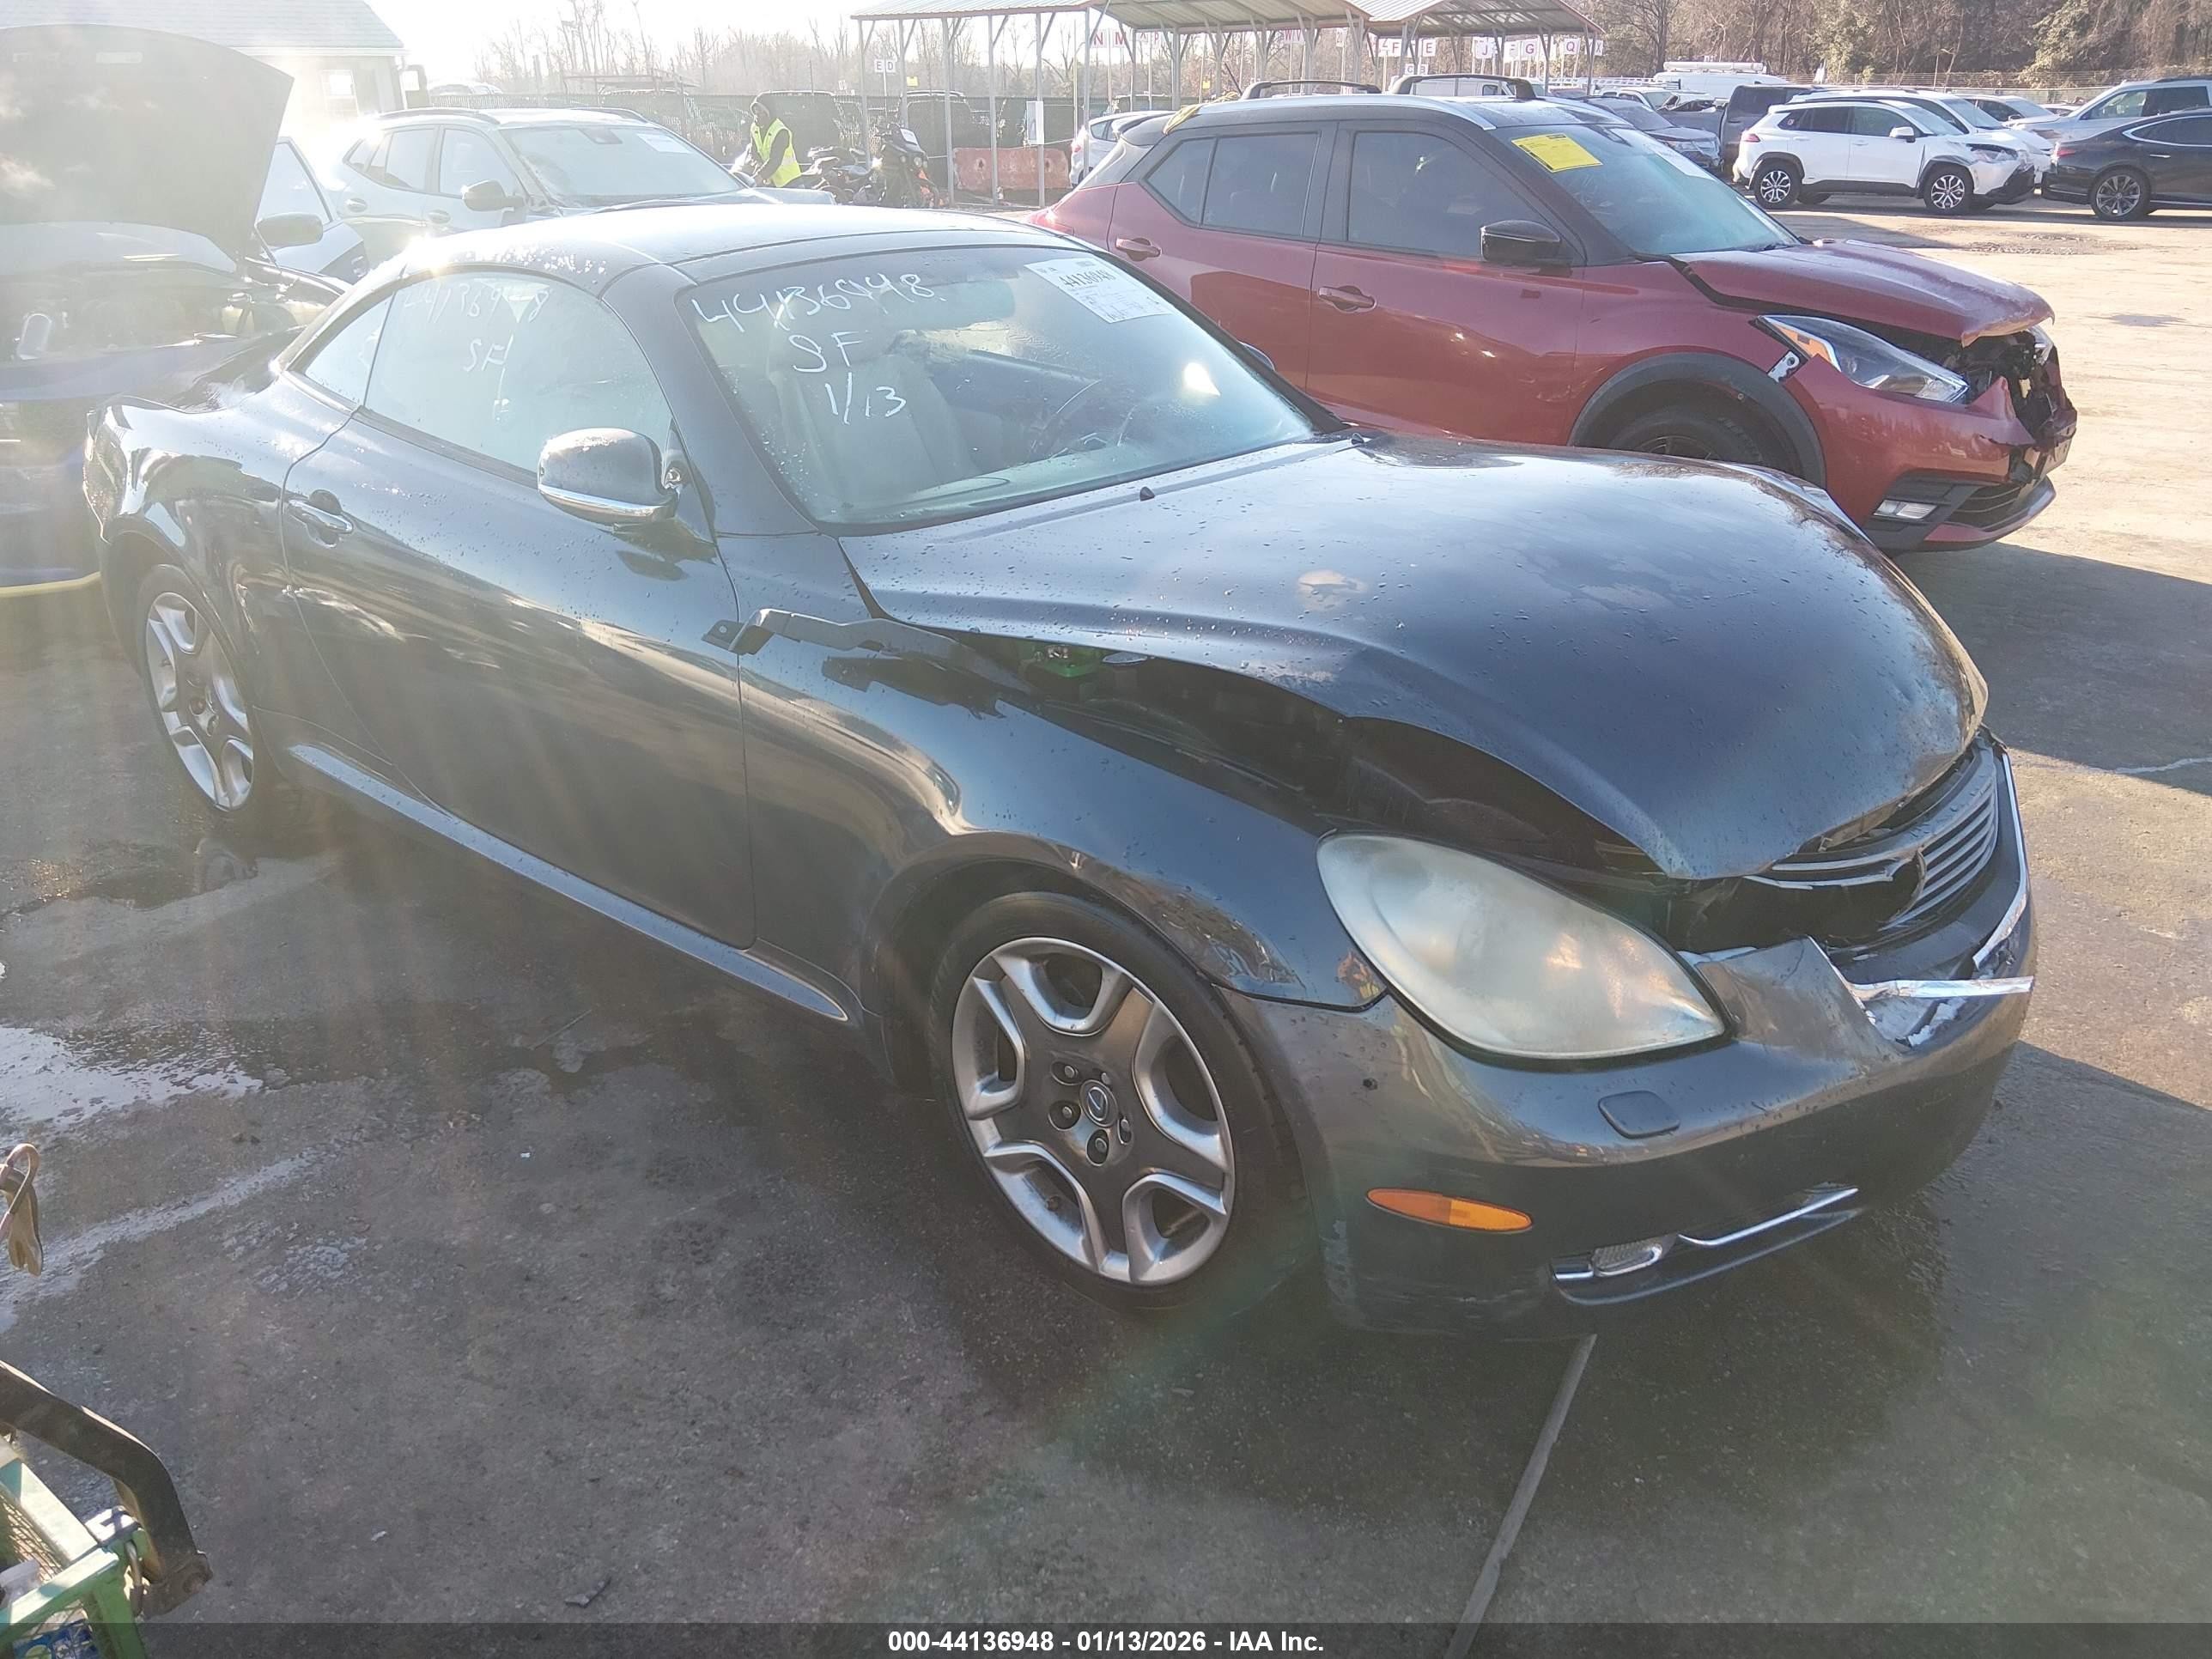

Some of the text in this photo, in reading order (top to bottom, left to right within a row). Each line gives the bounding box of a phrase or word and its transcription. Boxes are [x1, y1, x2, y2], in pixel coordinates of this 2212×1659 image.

[1094, 32, 1103, 46] N
[1425, 42, 1433, 54] E
[1525, 43, 1534, 54] G
[1565, 41, 1576, 52] Q
[876, 61, 894, 70] E D
[824, 372, 907, 425] 1/13
